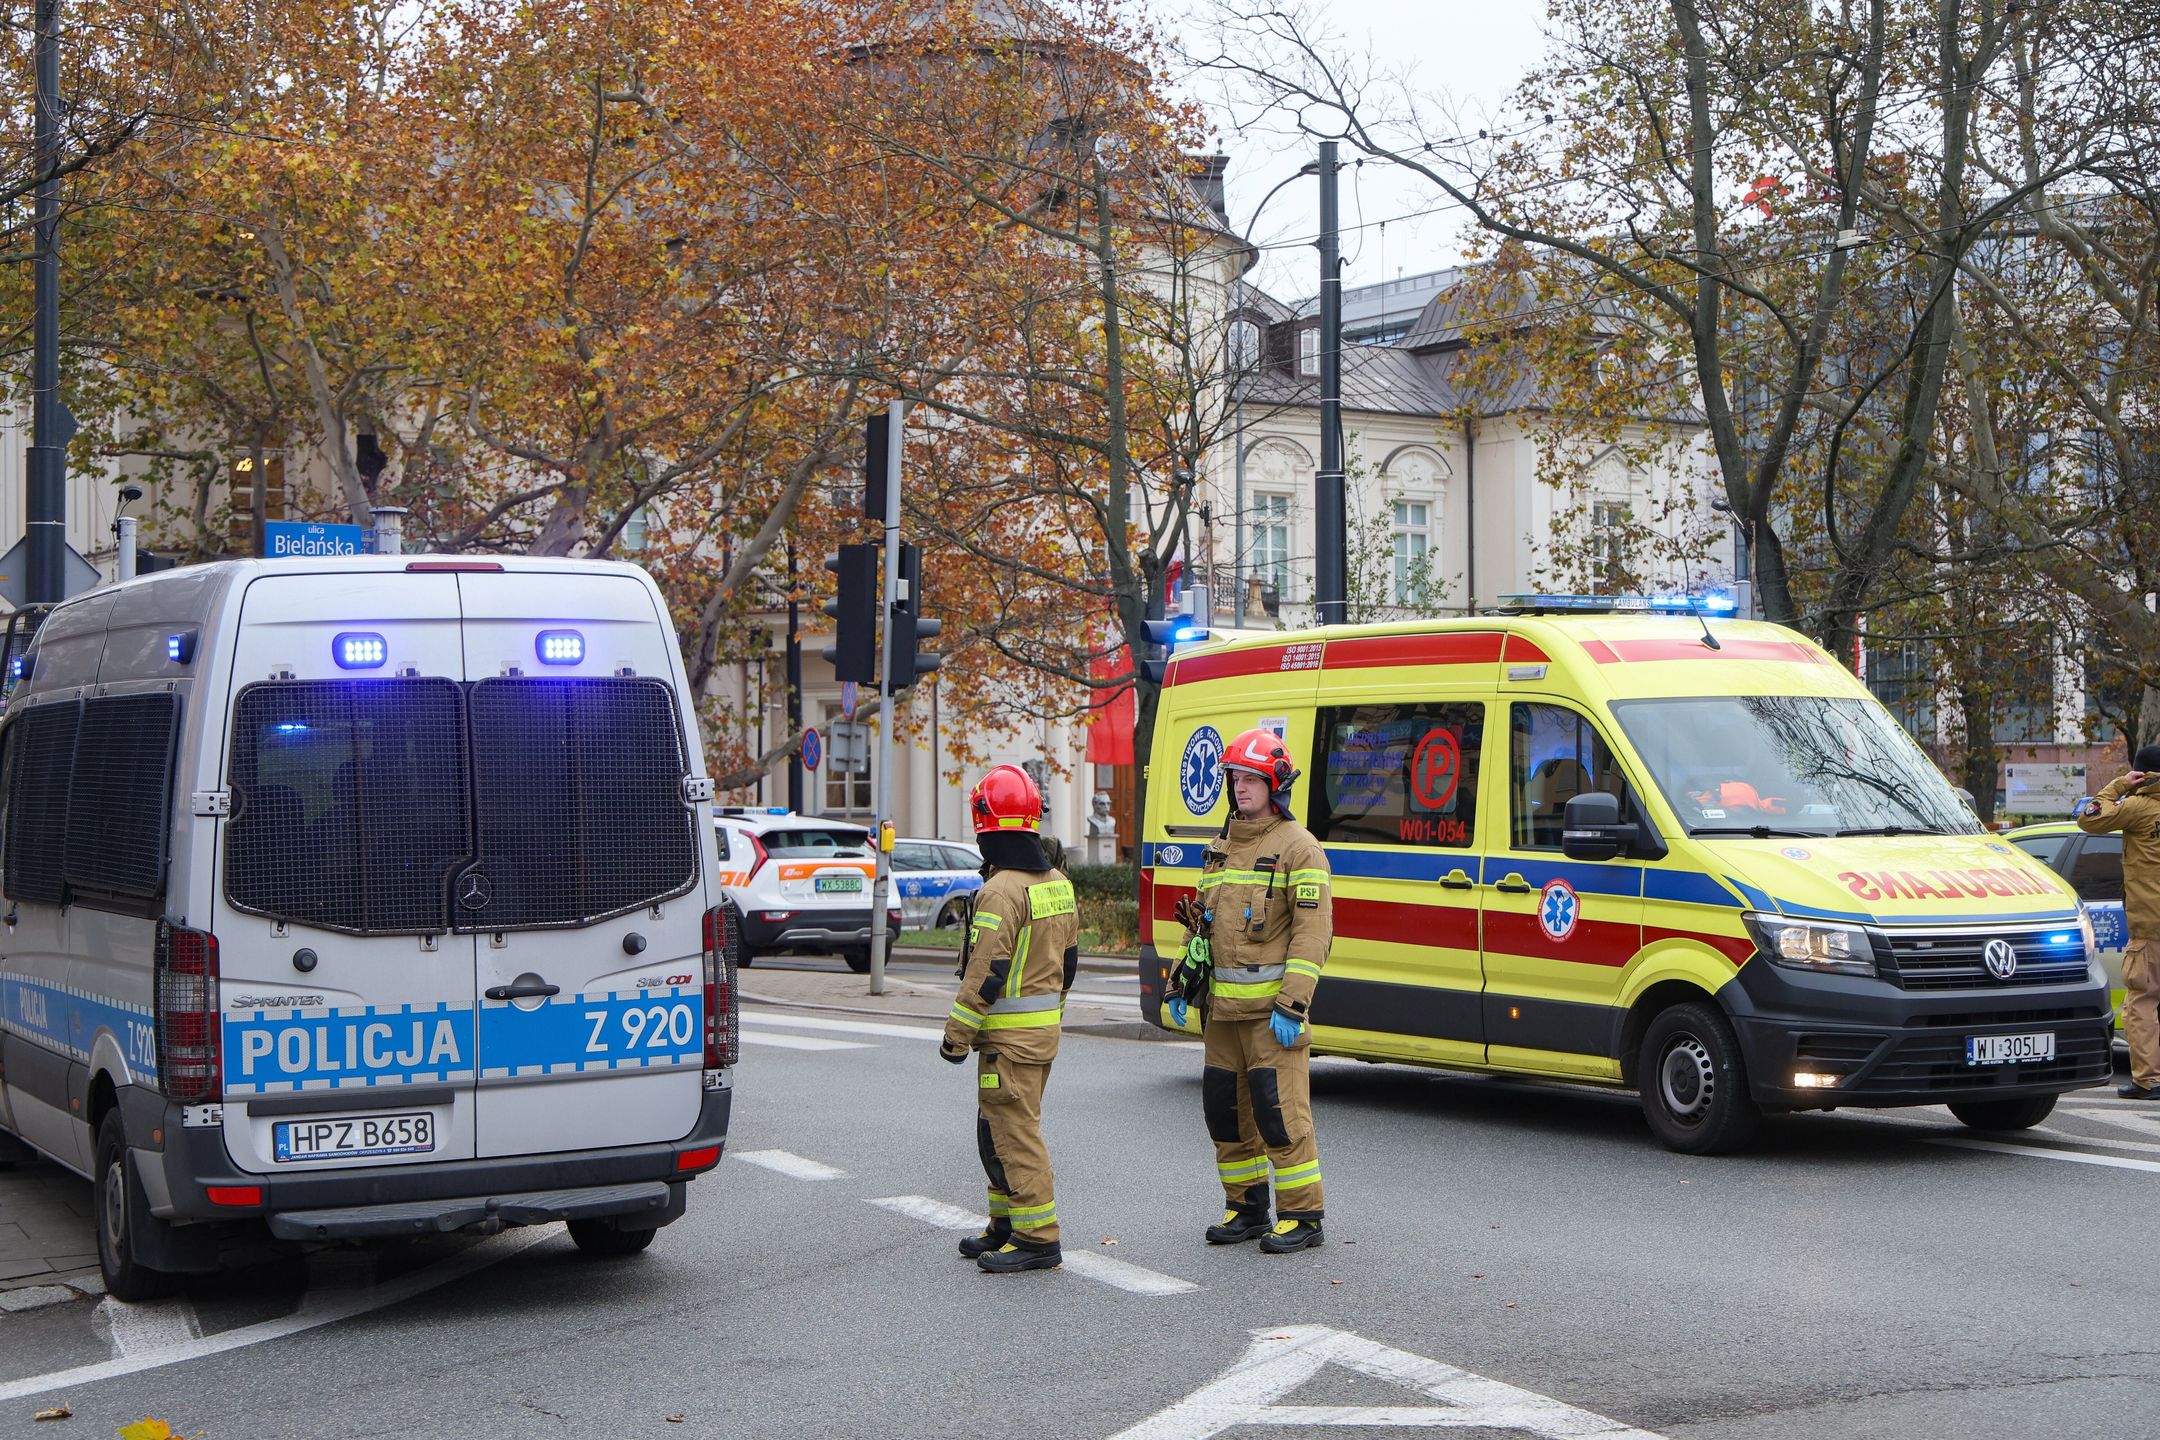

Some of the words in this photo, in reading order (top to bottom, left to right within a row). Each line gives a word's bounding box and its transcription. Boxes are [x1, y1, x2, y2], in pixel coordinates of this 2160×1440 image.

[308, 526, 324, 534] ulica
[275, 535, 354, 555] Bielańska
[1186, 794, 1216, 813] MEDYCZNE
[1400, 820, 1465, 842] W01-054
[821, 880, 833, 890] WX
[1300, 888, 1317, 897] PSP
[665, 974, 692, 986] CDI
[19, 986, 48, 1030] POLICJA
[231, 995, 324, 1009] SPRINTER
[584, 1010, 608, 1053] Z
[621, 1003, 693, 1050] 920
[127, 1020, 136, 1062] Z
[136, 1023, 156, 1069] 920
[241, 1019, 461, 1076] POLICJA
[1977, 1039, 1995, 1059] WI
[2004, 1035, 2050, 1057] 305LJ
[278, 1143, 288, 1151] PL
[294, 1122, 354, 1152] HPZ
[363, 1118, 429, 1147] B658
